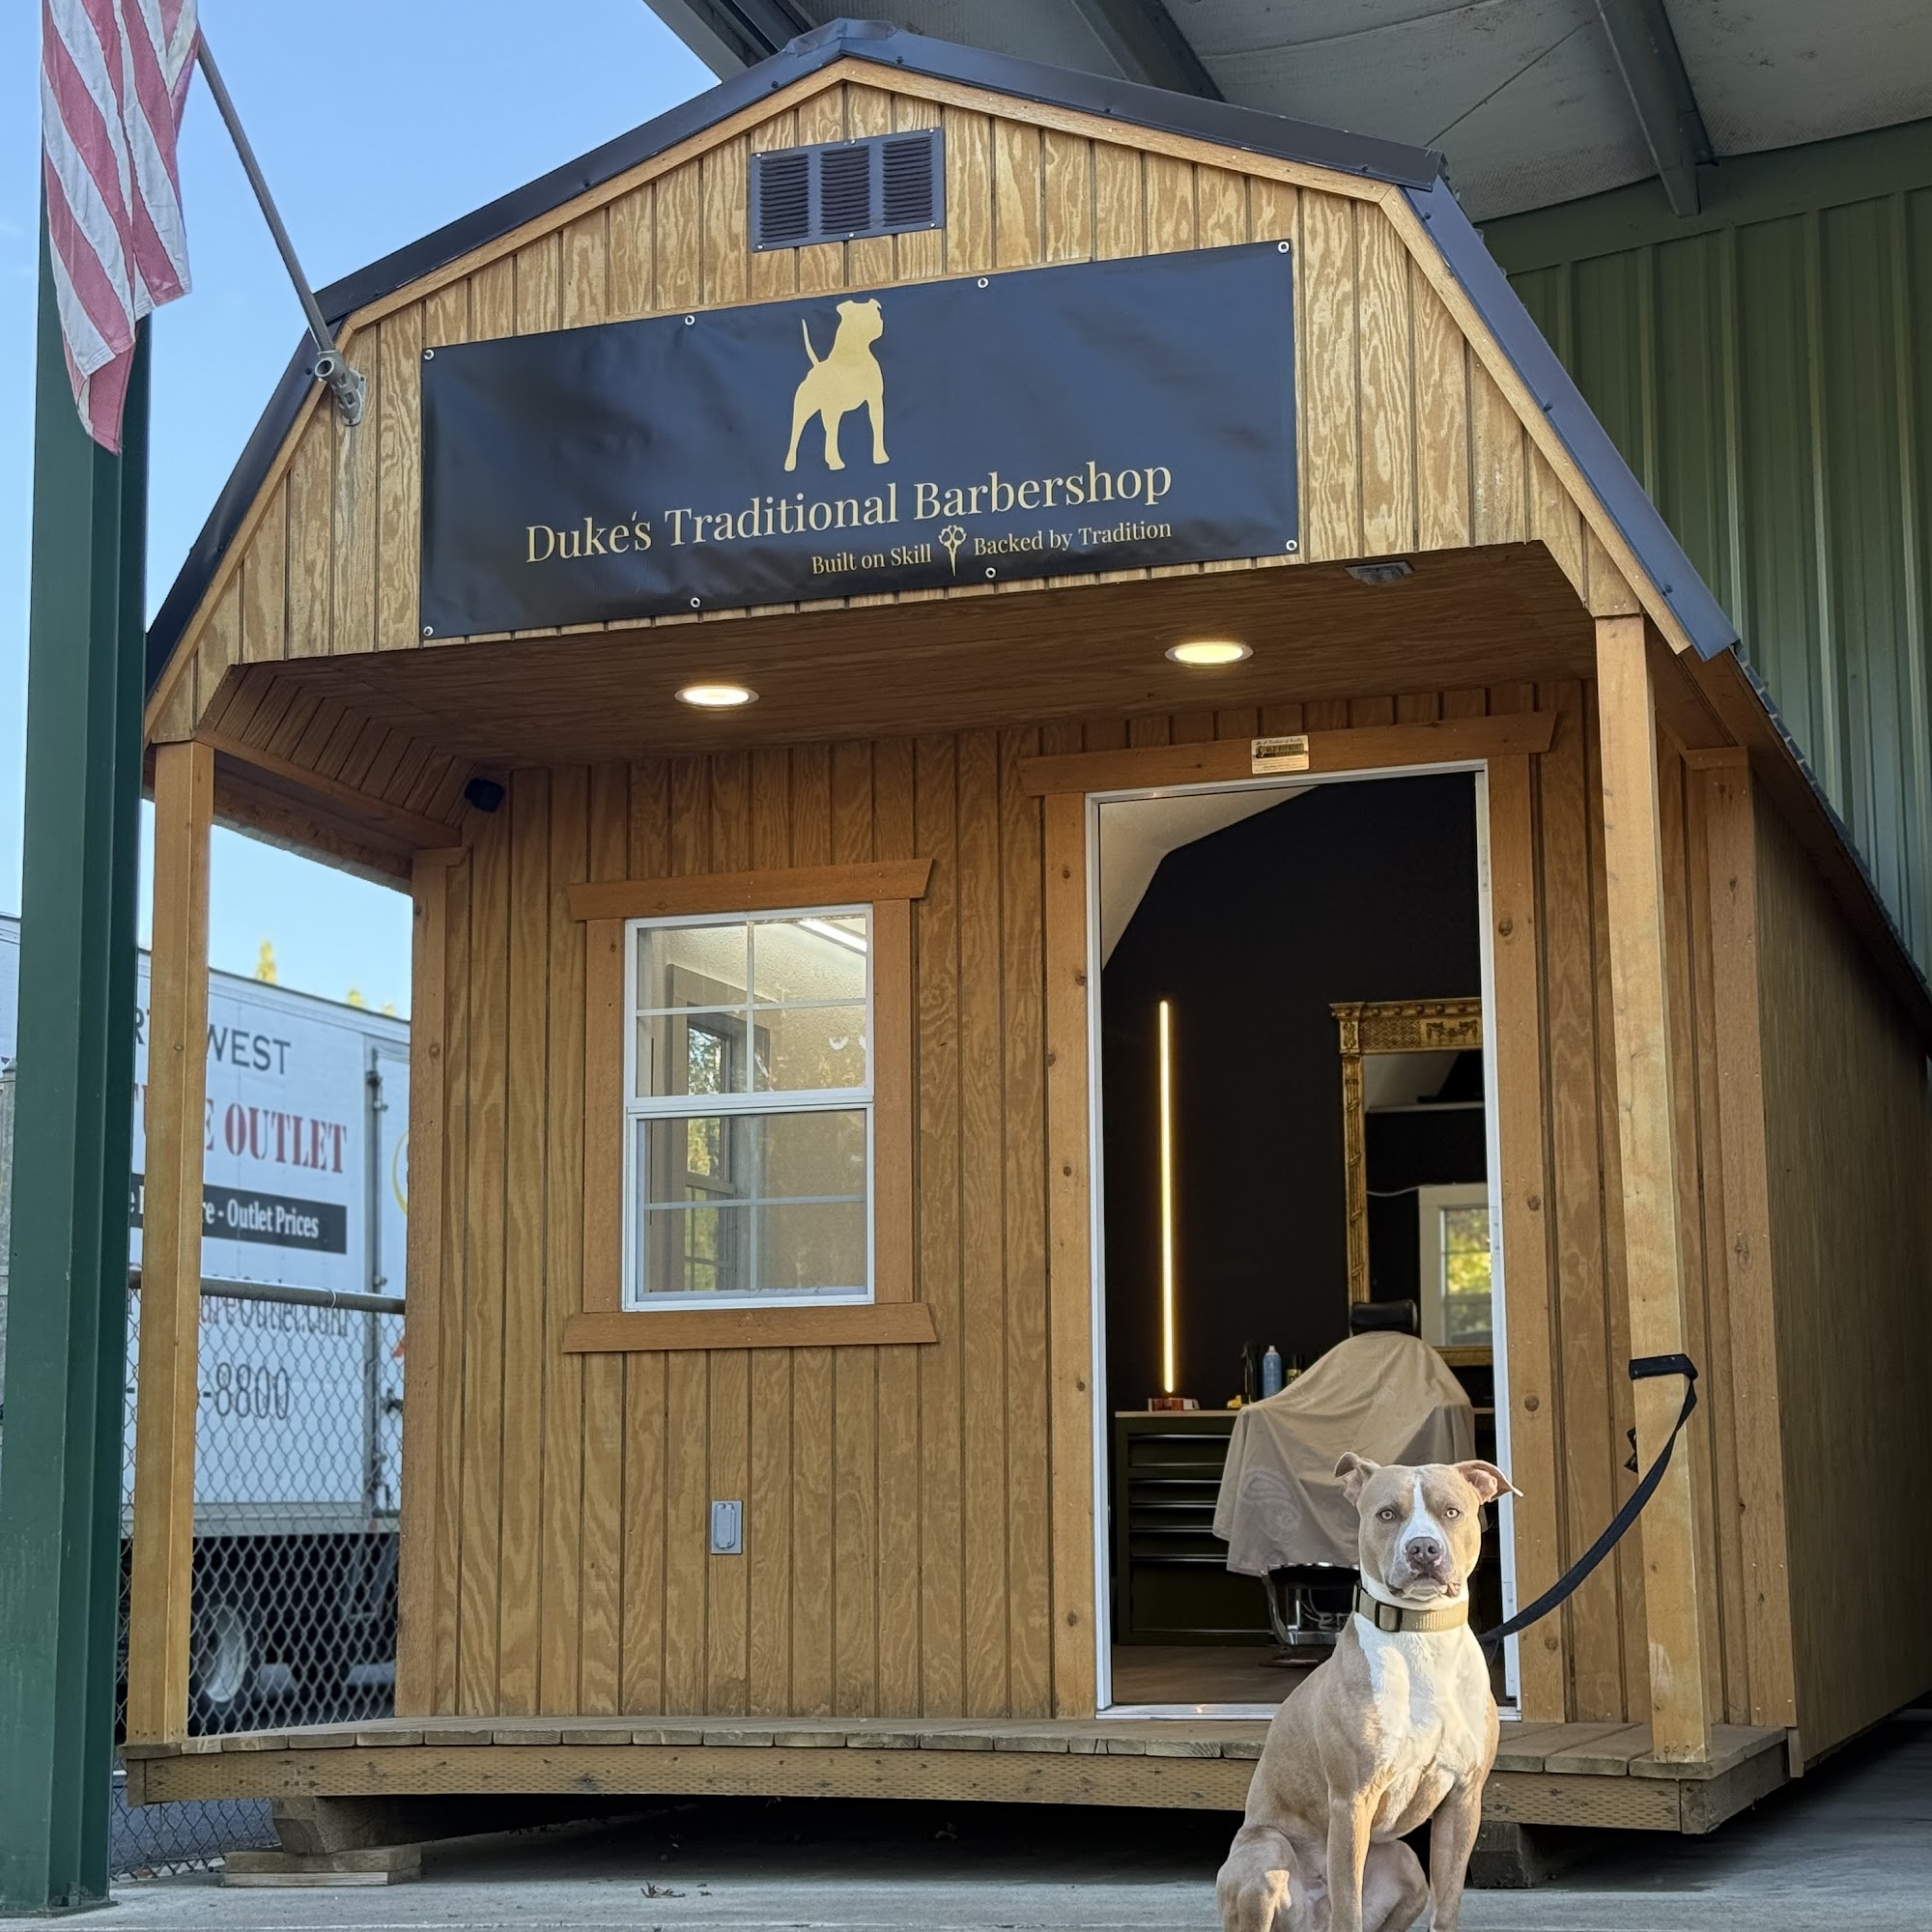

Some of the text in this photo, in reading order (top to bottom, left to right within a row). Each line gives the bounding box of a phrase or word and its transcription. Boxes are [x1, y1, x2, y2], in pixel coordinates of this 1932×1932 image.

[526, 461, 1172, 563] Duke's Traditional Barbershop
[974, 521, 1172, 556] Backed by Tradition
[811, 544, 931, 575] Built on Skill
[224, 1101, 347, 1174] OUTLET
[227, 1198, 273, 1233] Outlet
[275, 1205, 320, 1238] Prices
